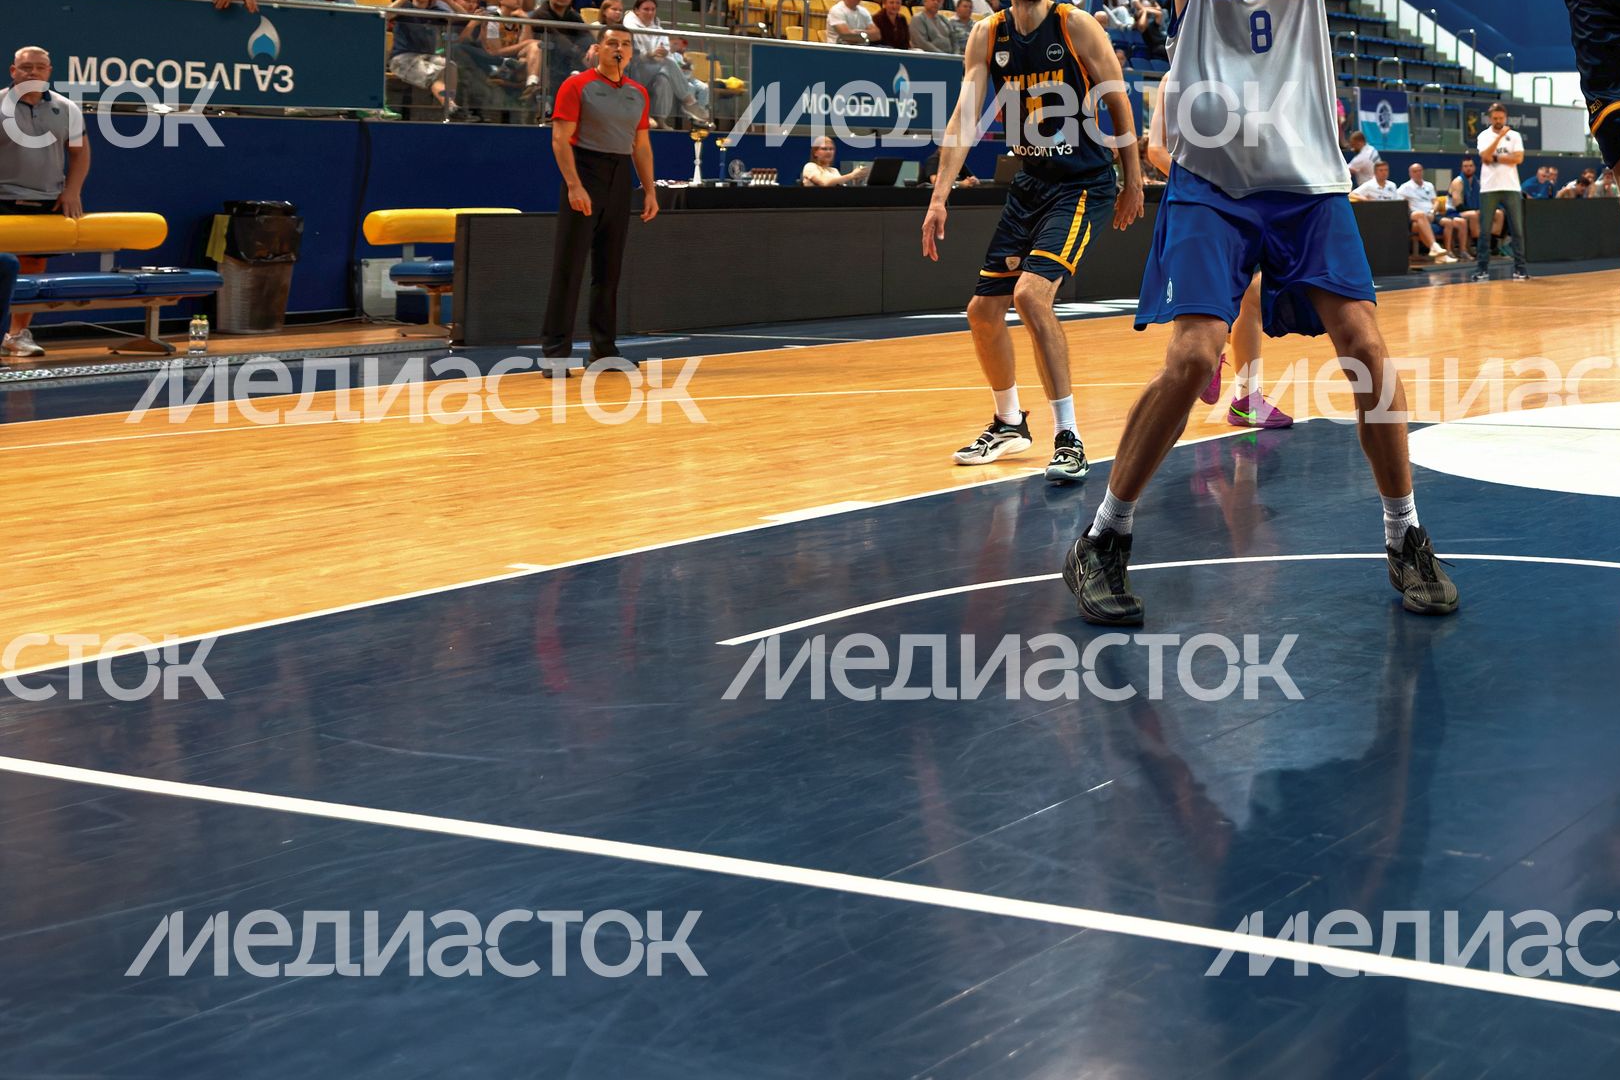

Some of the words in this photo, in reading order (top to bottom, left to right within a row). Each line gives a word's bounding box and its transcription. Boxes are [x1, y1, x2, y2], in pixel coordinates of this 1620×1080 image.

[1249, 10, 1273, 55] 8
[67, 55, 295, 94] МОСОБЛГАЗ
[802, 92, 918, 120] МОСОБЛГАЗ
